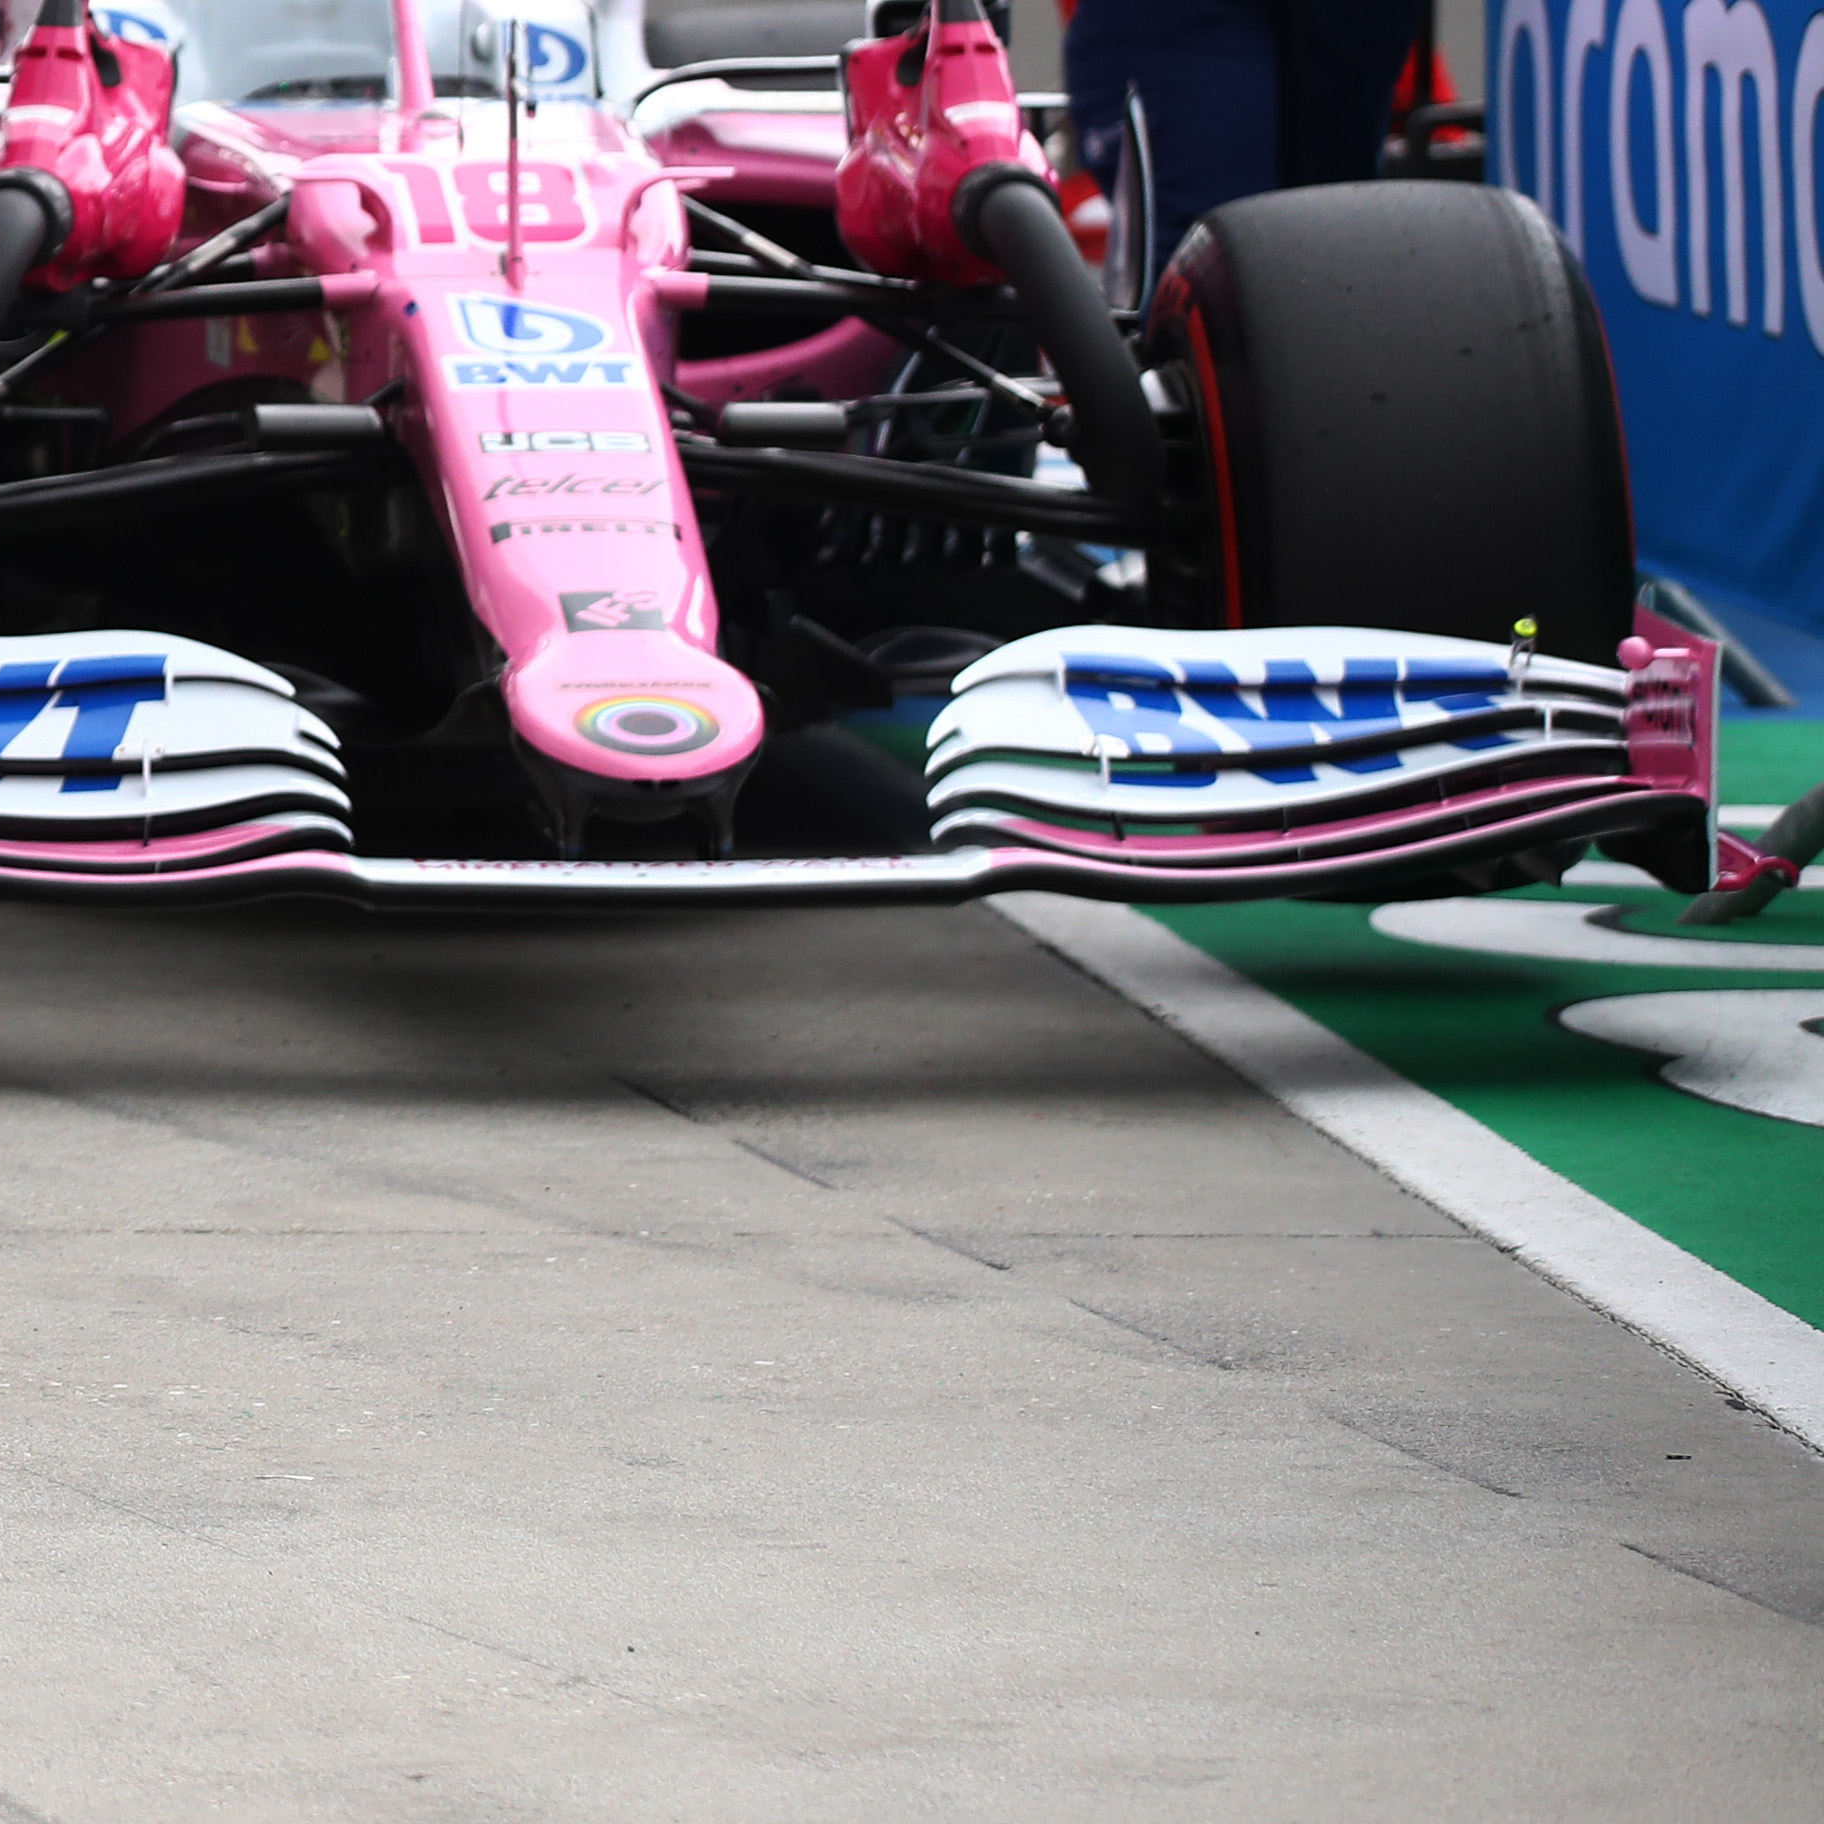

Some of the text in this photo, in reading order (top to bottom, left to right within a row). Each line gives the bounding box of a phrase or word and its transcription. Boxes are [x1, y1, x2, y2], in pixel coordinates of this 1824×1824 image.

[387, 160, 588, 245] 18
[455, 361, 633, 386] BWT
[481, 433, 650, 454] JCB
[483, 473, 667, 501] telcel
[1060, 652, 1526, 789] BWT
